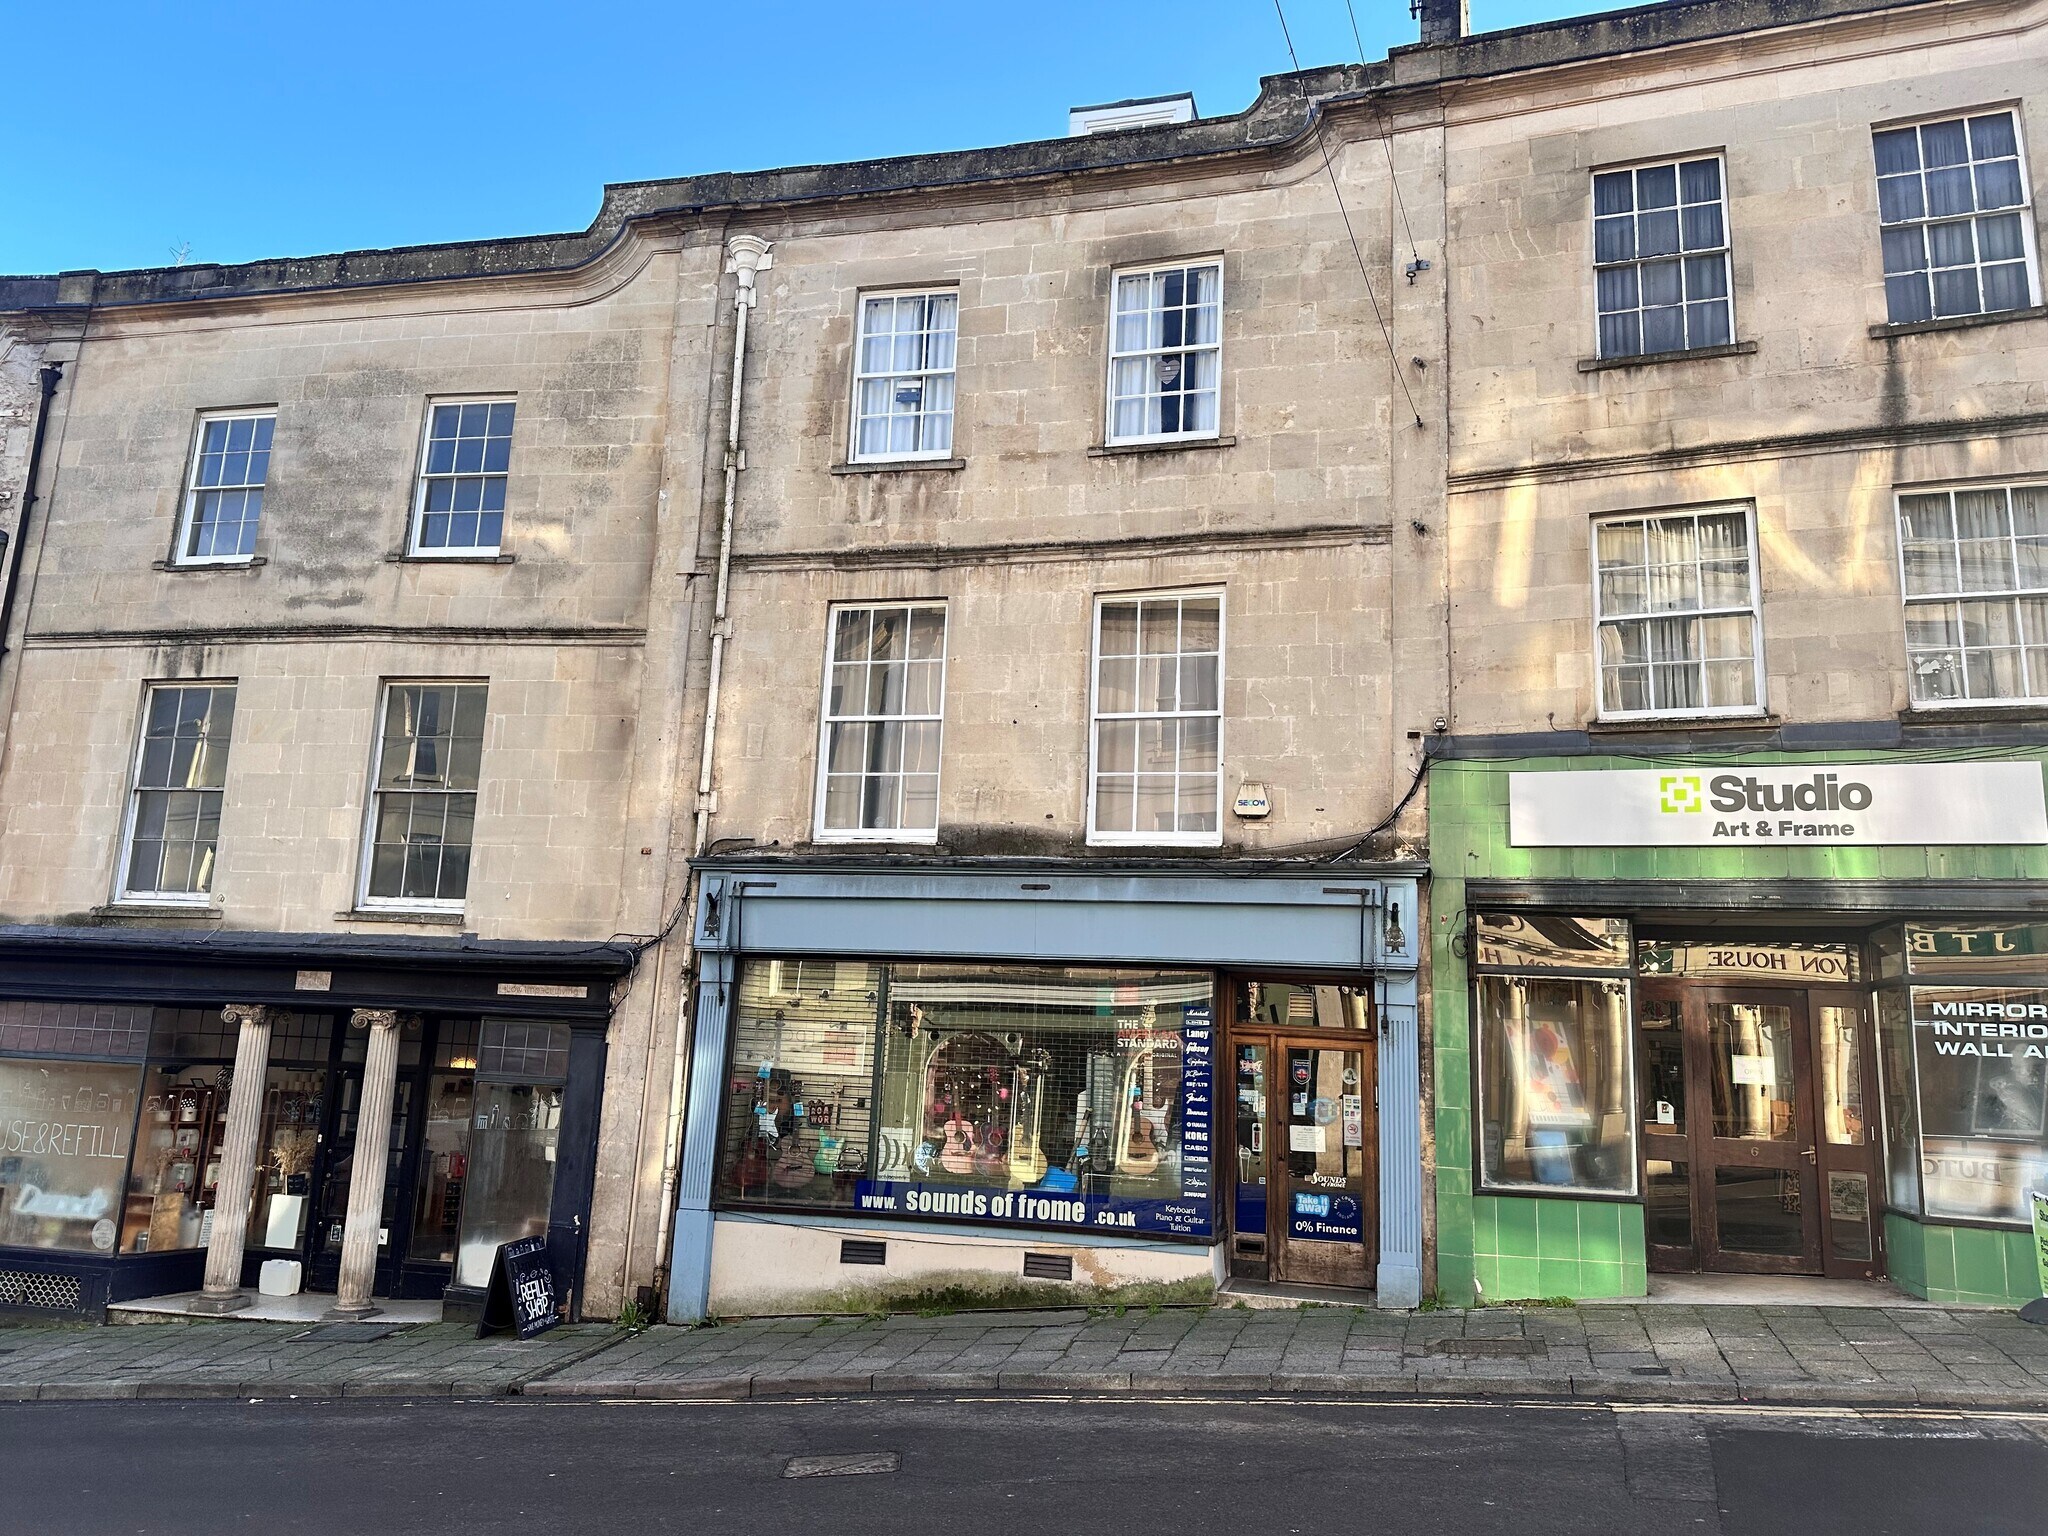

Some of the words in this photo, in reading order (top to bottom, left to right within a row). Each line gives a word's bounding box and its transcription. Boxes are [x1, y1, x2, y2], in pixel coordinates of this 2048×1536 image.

[1709, 773, 1873, 813] Studio
[1237, 799, 1266, 807] SECOM
[1712, 821, 1750, 837] Art
[1755, 820, 1773, 837] &
[1778, 820, 1855, 837] Frame
[1117, 1019, 1139, 1029] THE
[1186, 1028, 1209, 1040] Laney
[1116, 1039, 1178, 1049] STANDARD
[1934, 1041, 2014, 1057] WALL
[1185, 1131, 1208, 1141] KORG
[1184, 1144, 1208, 1152] CASIO
[1750, 1146, 1760, 1157] 6
[1297, 1195, 1319, 1205] Take
[862, 1195, 897, 1209] www.
[906, 1190, 987, 1215] sounds
[991, 1193, 1014, 1217] of
[1018, 1194, 1086, 1223] frome
[1094, 1211, 1136, 1227] .co.uk
[1165, 1204, 1196, 1215] Keyboard
[1297, 1203, 1329, 1216] away
[1155, 1212, 1173, 1222] Piano
[1183, 1215, 1205, 1224] Guitar
[1169, 1222, 1191, 1232] Tuition
[1295, 1220, 1314, 1233] 0%
[1316, 1222, 1358, 1235] Finance
[526, 1296, 549, 1320] SHOP
